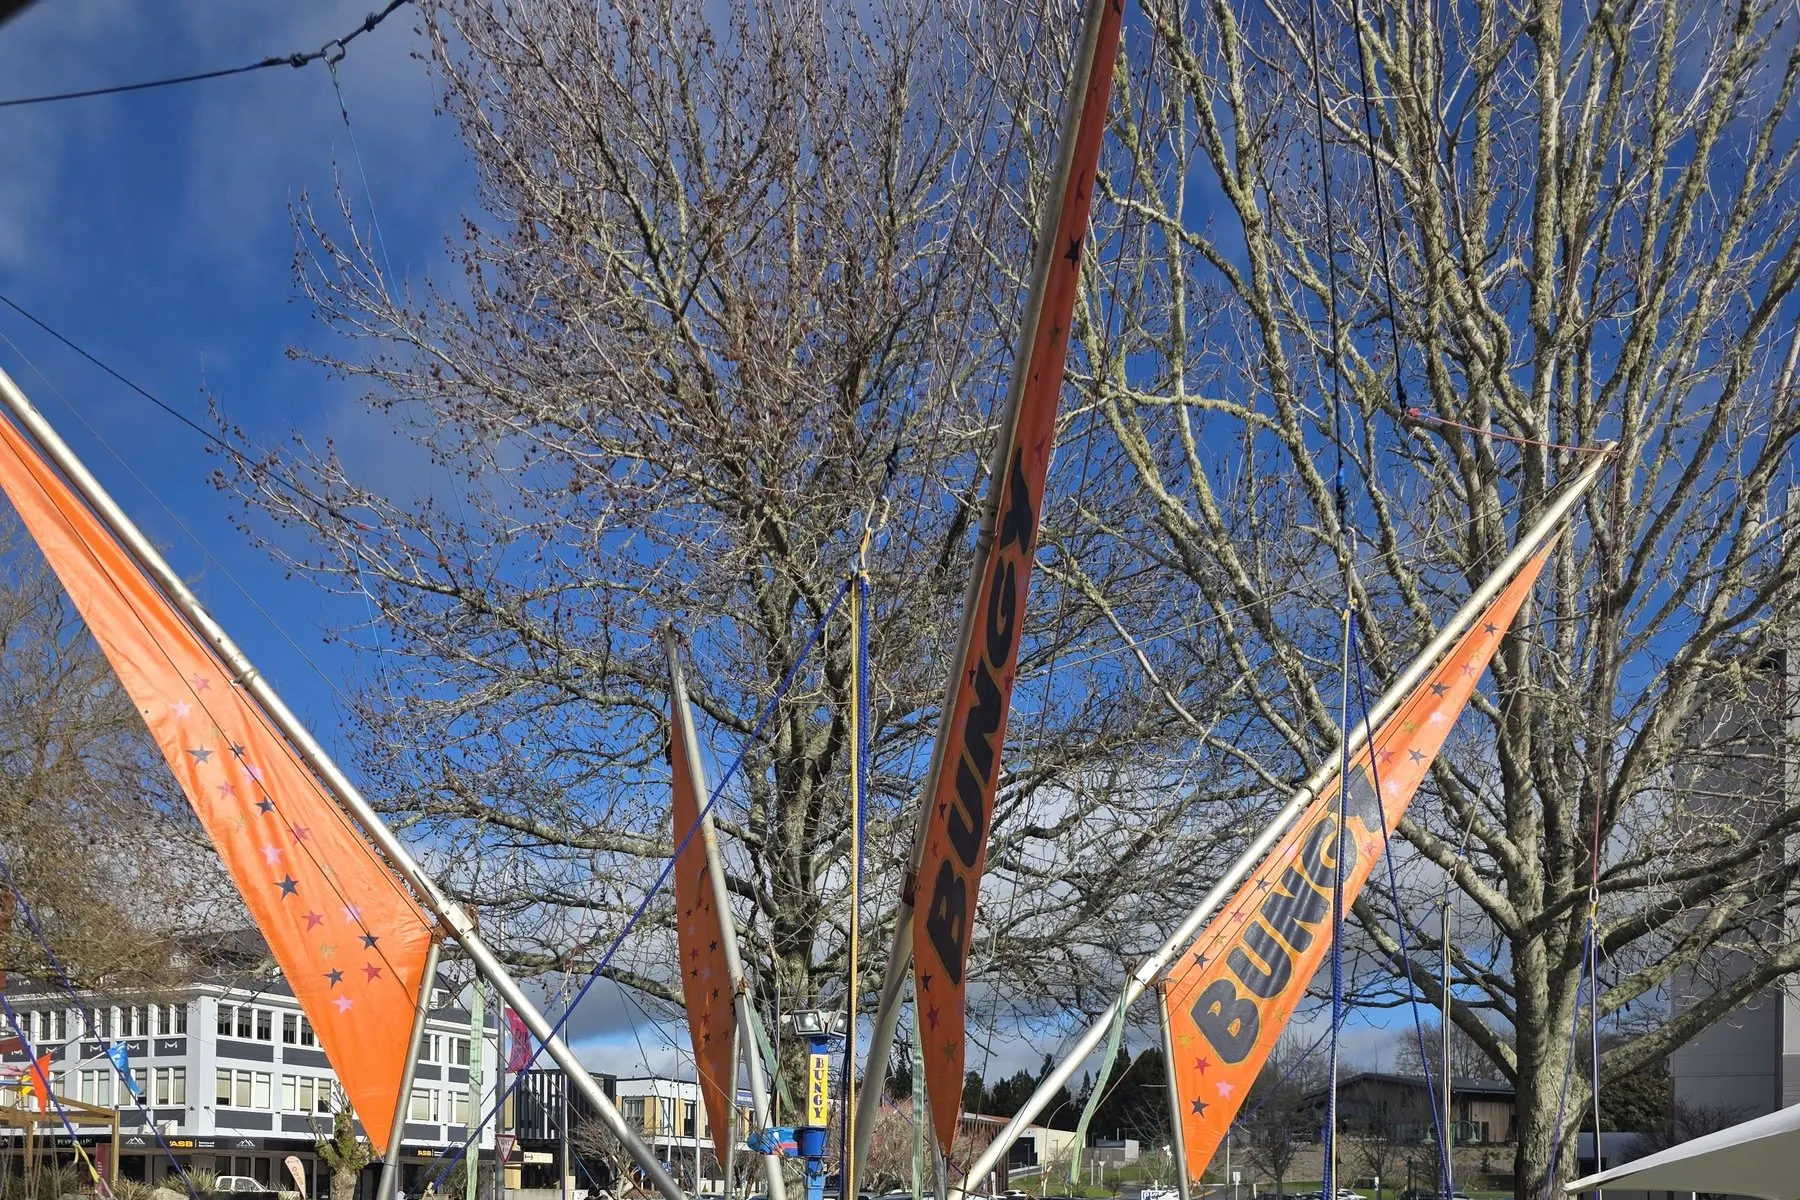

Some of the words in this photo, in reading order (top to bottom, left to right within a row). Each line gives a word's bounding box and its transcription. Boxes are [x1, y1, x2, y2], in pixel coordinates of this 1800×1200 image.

[926, 446, 1034, 986] BUNGY
[1190, 764, 1386, 1064] BUNGY
[169, 1140, 193, 1148] ASB
[813, 1057, 825, 1118] BUNGY
